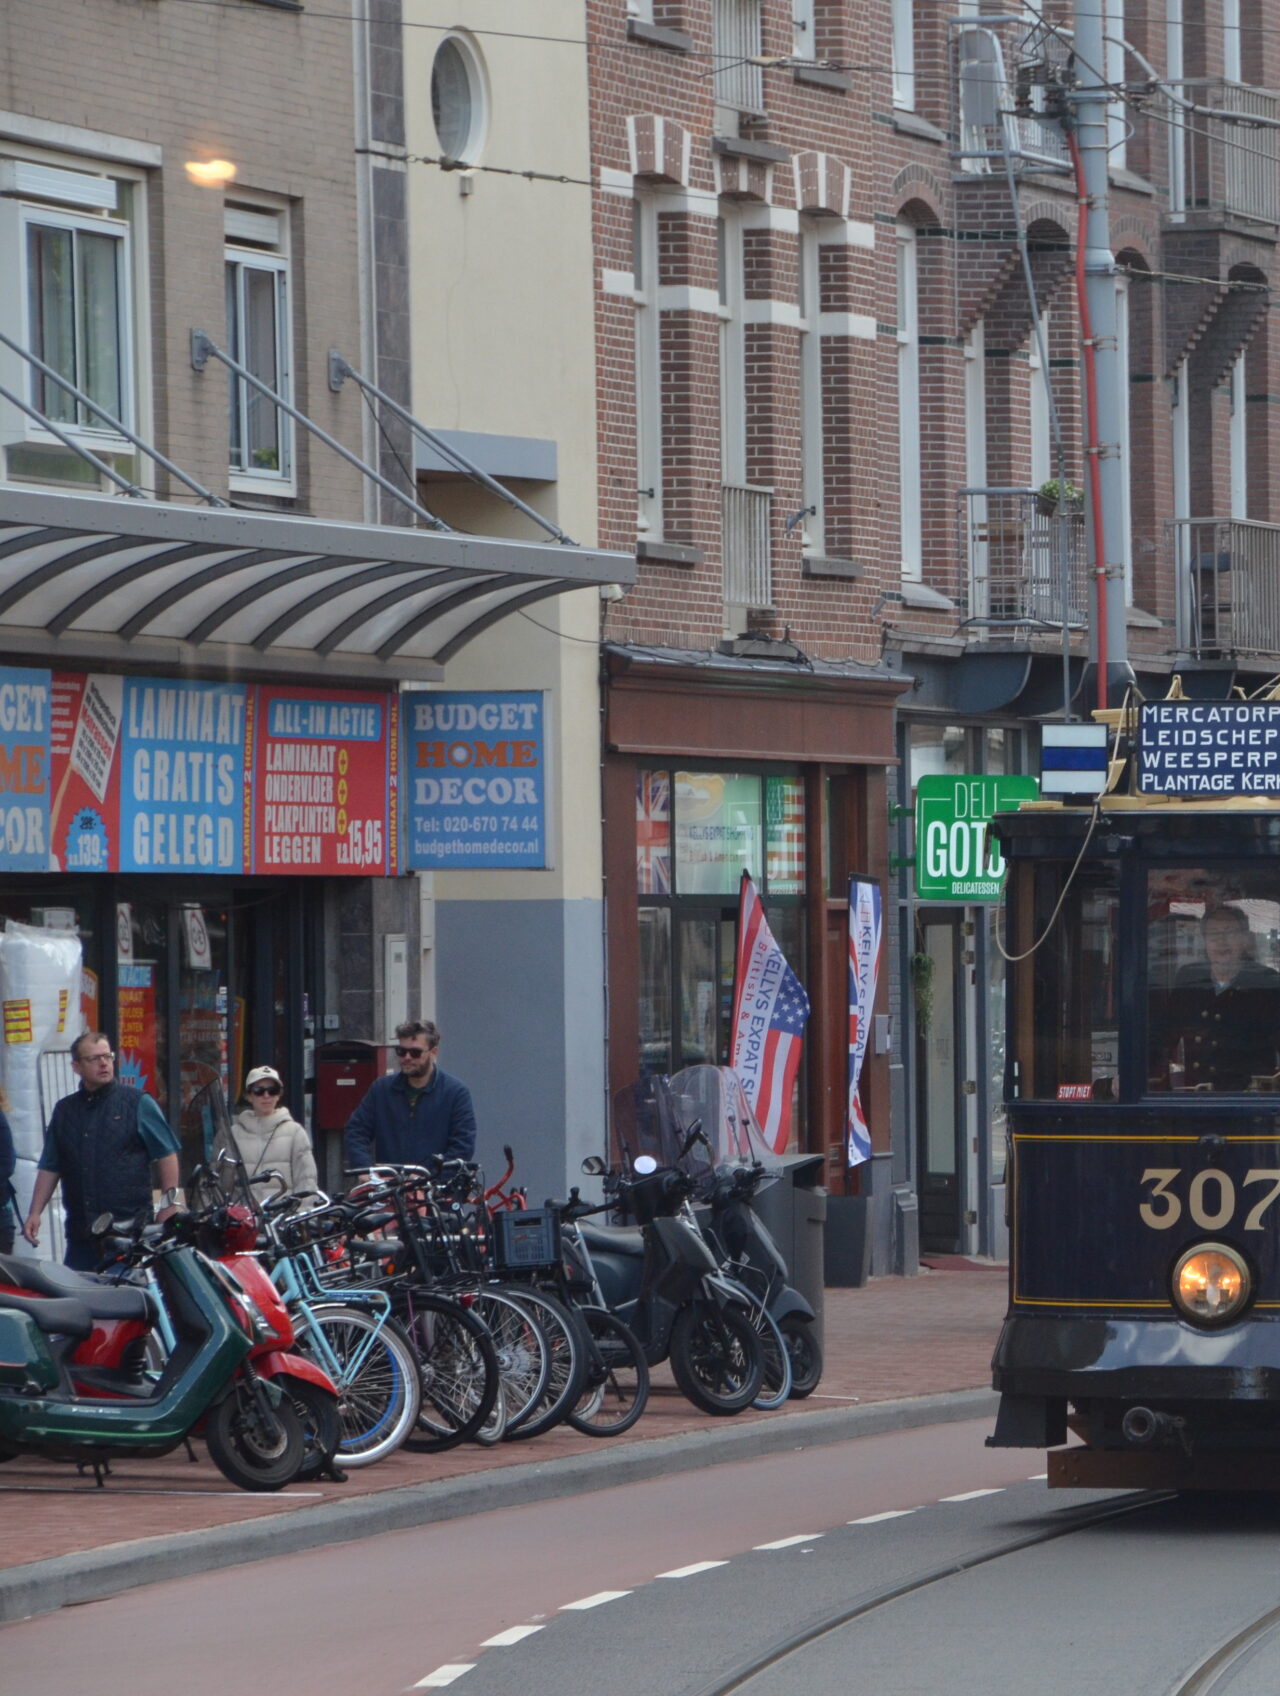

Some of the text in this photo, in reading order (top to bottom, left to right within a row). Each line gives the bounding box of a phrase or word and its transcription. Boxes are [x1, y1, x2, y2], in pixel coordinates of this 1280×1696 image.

[129, 686, 244, 745] LAMINAAT
[274, 703, 375, 737] ALL-IN ACTIE
[414, 703, 538, 731] BUDGET
[266, 743, 336, 772] LAMINAAT
[415, 740, 538, 768] HOME
[133, 748, 234, 805] GRATIS
[265, 774, 334, 803] ONDERVLOER
[414, 777, 538, 805] DECOR
[1142, 773, 1235, 791] PLANTAGE
[955, 782, 997, 818] DELI
[265, 805, 336, 834] PLAKPLINTEN
[389, 790, 398, 867] LAMINAAT
[414, 816, 538, 832] Tel: 020-670 74 44
[133, 812, 234, 868] GELEGD
[265, 835, 321, 863] LEGGEN
[348, 819, 382, 868] 15,95
[415, 838, 539, 858] budgethomedecor.nl
[952, 881, 999, 895] DELICATESSEN
[745, 942, 768, 1001] British
[756, 947, 782, 1010] KELLYS
[742, 1015, 765, 1075] EXPAT
[1076, 1086, 1091, 1098] NIET
